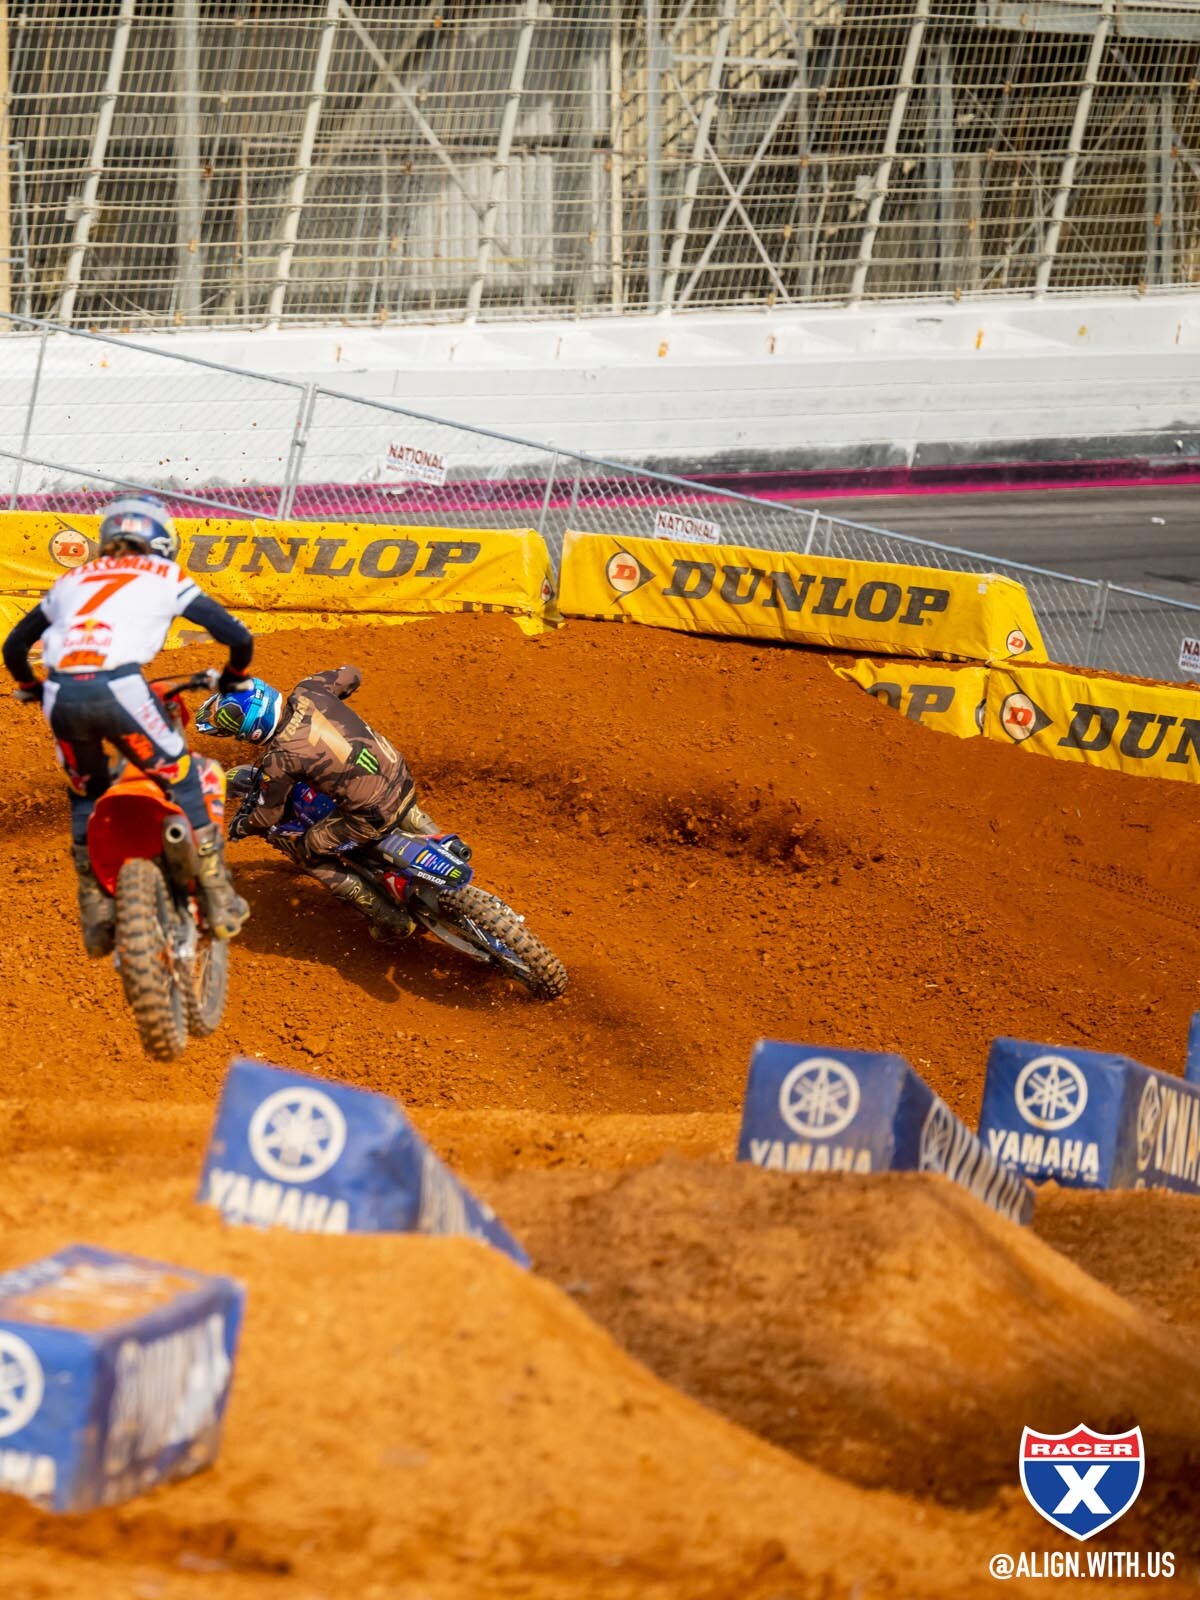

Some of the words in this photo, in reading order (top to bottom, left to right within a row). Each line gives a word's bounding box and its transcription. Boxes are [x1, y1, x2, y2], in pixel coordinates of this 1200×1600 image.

[388, 444, 445, 470] NATIONAL
[658, 514, 717, 540] NATIONAL
[187, 534, 482, 579] UNLOP
[79, 573, 140, 616] 7
[662, 558, 950, 626] DUNLOP
[417, 871, 447, 885] DUNLOP
[750, 1138, 873, 1174] YAMAHA
[988, 1128, 1099, 1173] YAMAHA
[209, 1167, 349, 1234] YAMAHA
